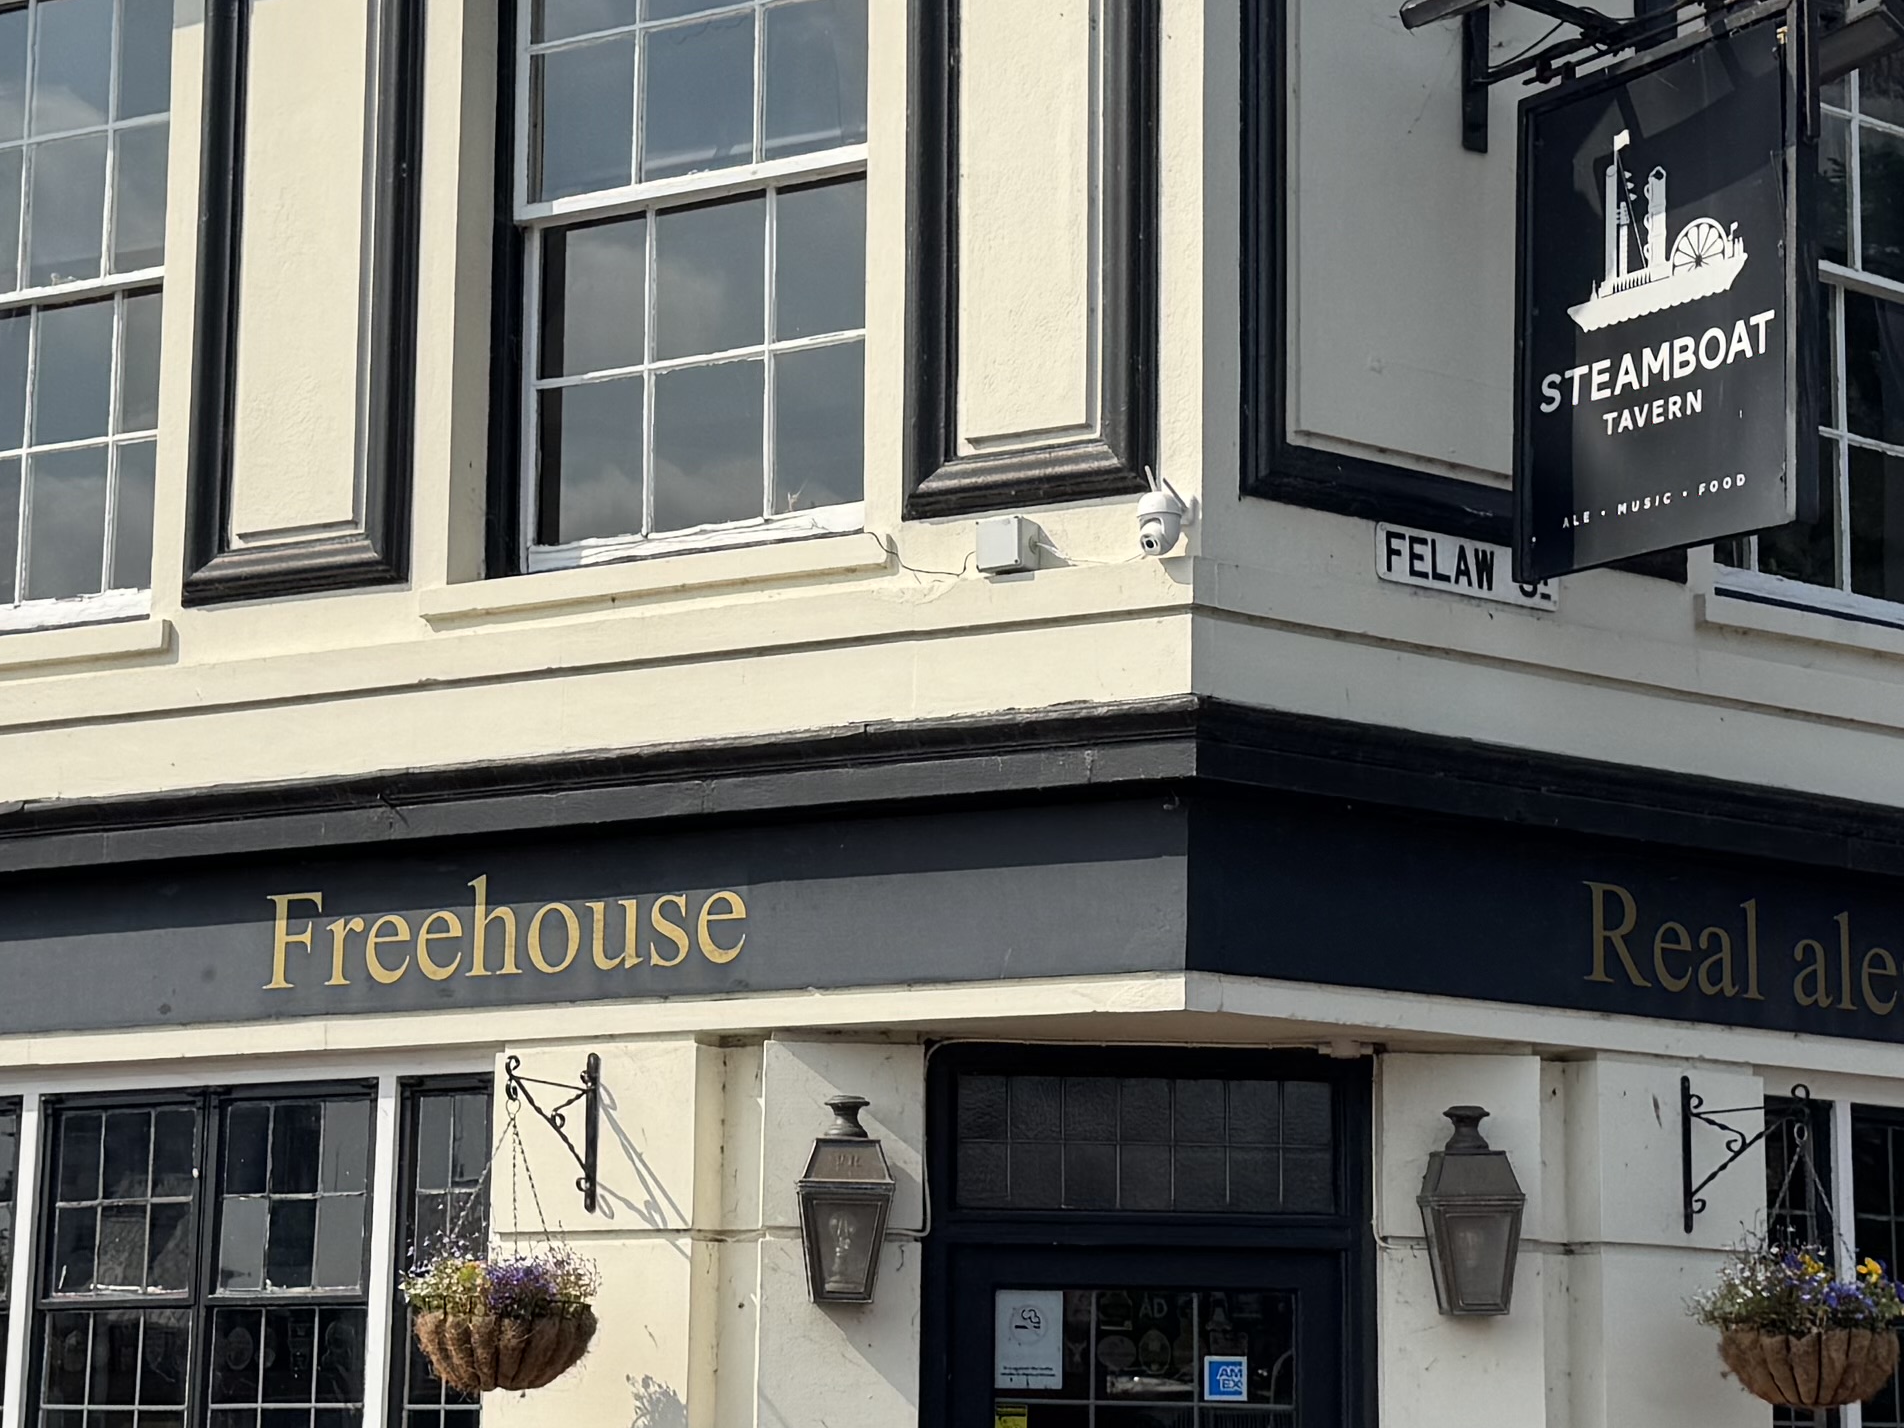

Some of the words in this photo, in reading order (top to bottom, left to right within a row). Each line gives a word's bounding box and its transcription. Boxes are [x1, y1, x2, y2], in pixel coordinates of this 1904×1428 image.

[1539, 308, 1775, 414] STEAMBOAT
[1602, 388, 1703, 436] TAVERN
[1562, 510, 1591, 529] ALE
[1616, 492, 1673, 515] MUSIC
[1698, 473, 1747, 496] FOOD
[1384, 529, 1495, 592] FELAW
[261, 873, 747, 990] Freehouse
[1582, 880, 1765, 1002] Real
[1217, 1365, 1243, 1380] AM
[1220, 1378, 1243, 1391] EX
